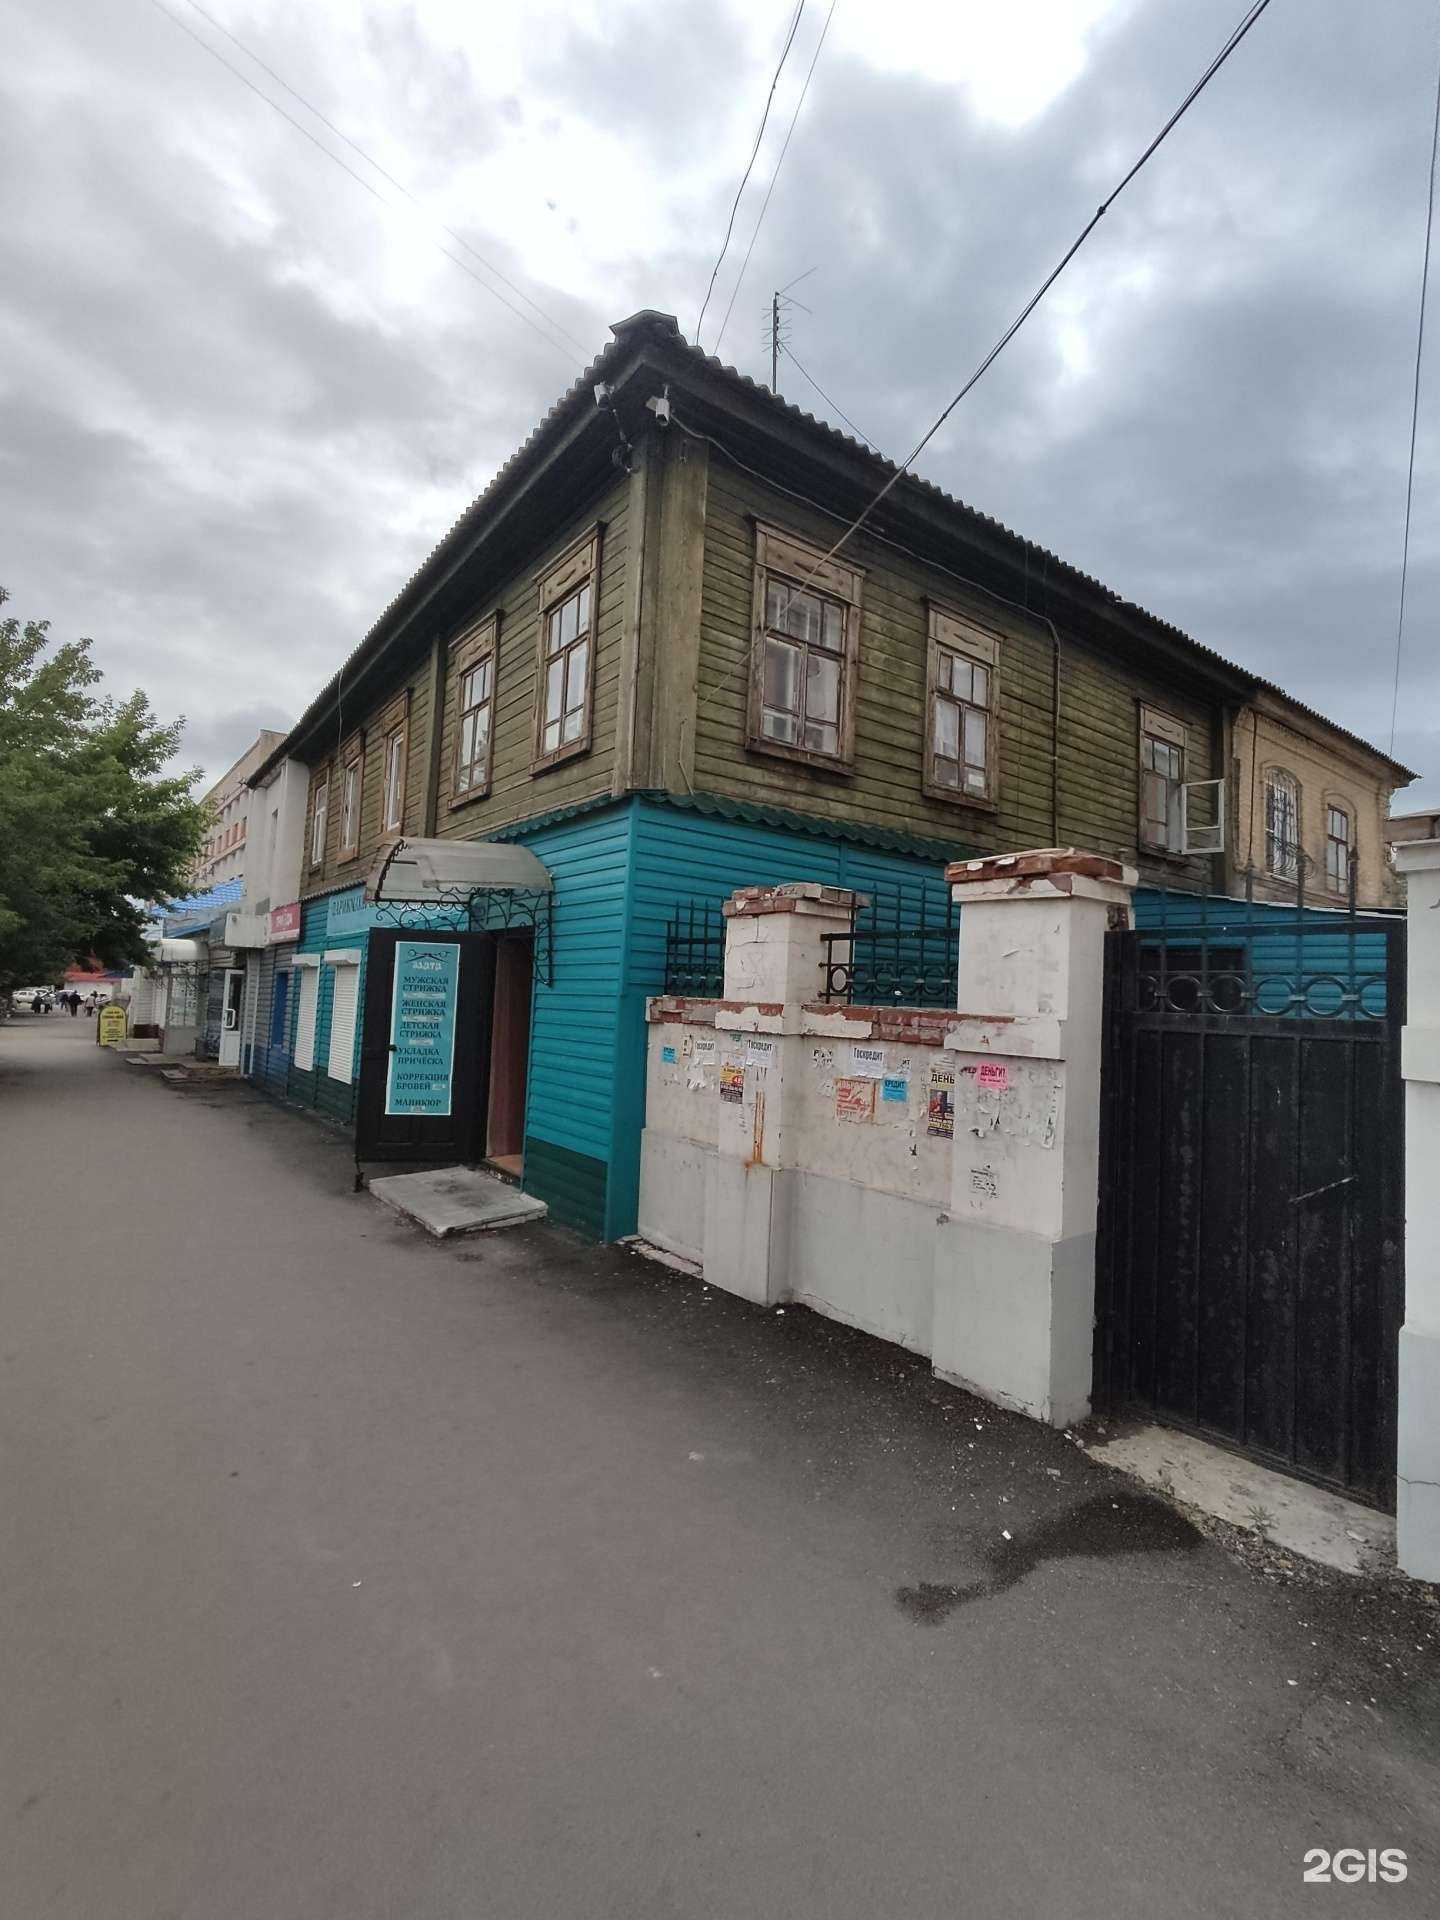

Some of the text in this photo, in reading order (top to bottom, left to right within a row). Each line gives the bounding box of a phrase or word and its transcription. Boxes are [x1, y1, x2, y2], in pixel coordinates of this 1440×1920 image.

[403, 976, 449, 985] МУЖСКАЯ
[402, 984, 447, 993] СТРИЖКА
[402, 999, 446, 1008] ЖЕНСКАЯ
[401, 1008, 446, 1016] СТРИЖКА
[400, 1022, 440, 1030] ДЕТСКАЯ
[399, 1030, 442, 1038] СТРИЖКА
[398, 1047, 440, 1055] УКЛАДКА
[854, 1048, 884, 1061] Госкредит
[981, 1066, 1006, 1076] ДЕНЬГИ?
[397, 1072, 449, 1081] КОРРЕКЦИЯ
[396, 1081, 431, 1090] БРОВЕЙ
[884, 1079, 905, 1088] КРЕДИТ
[395, 1098, 442, 1106] МАНИКЮР
